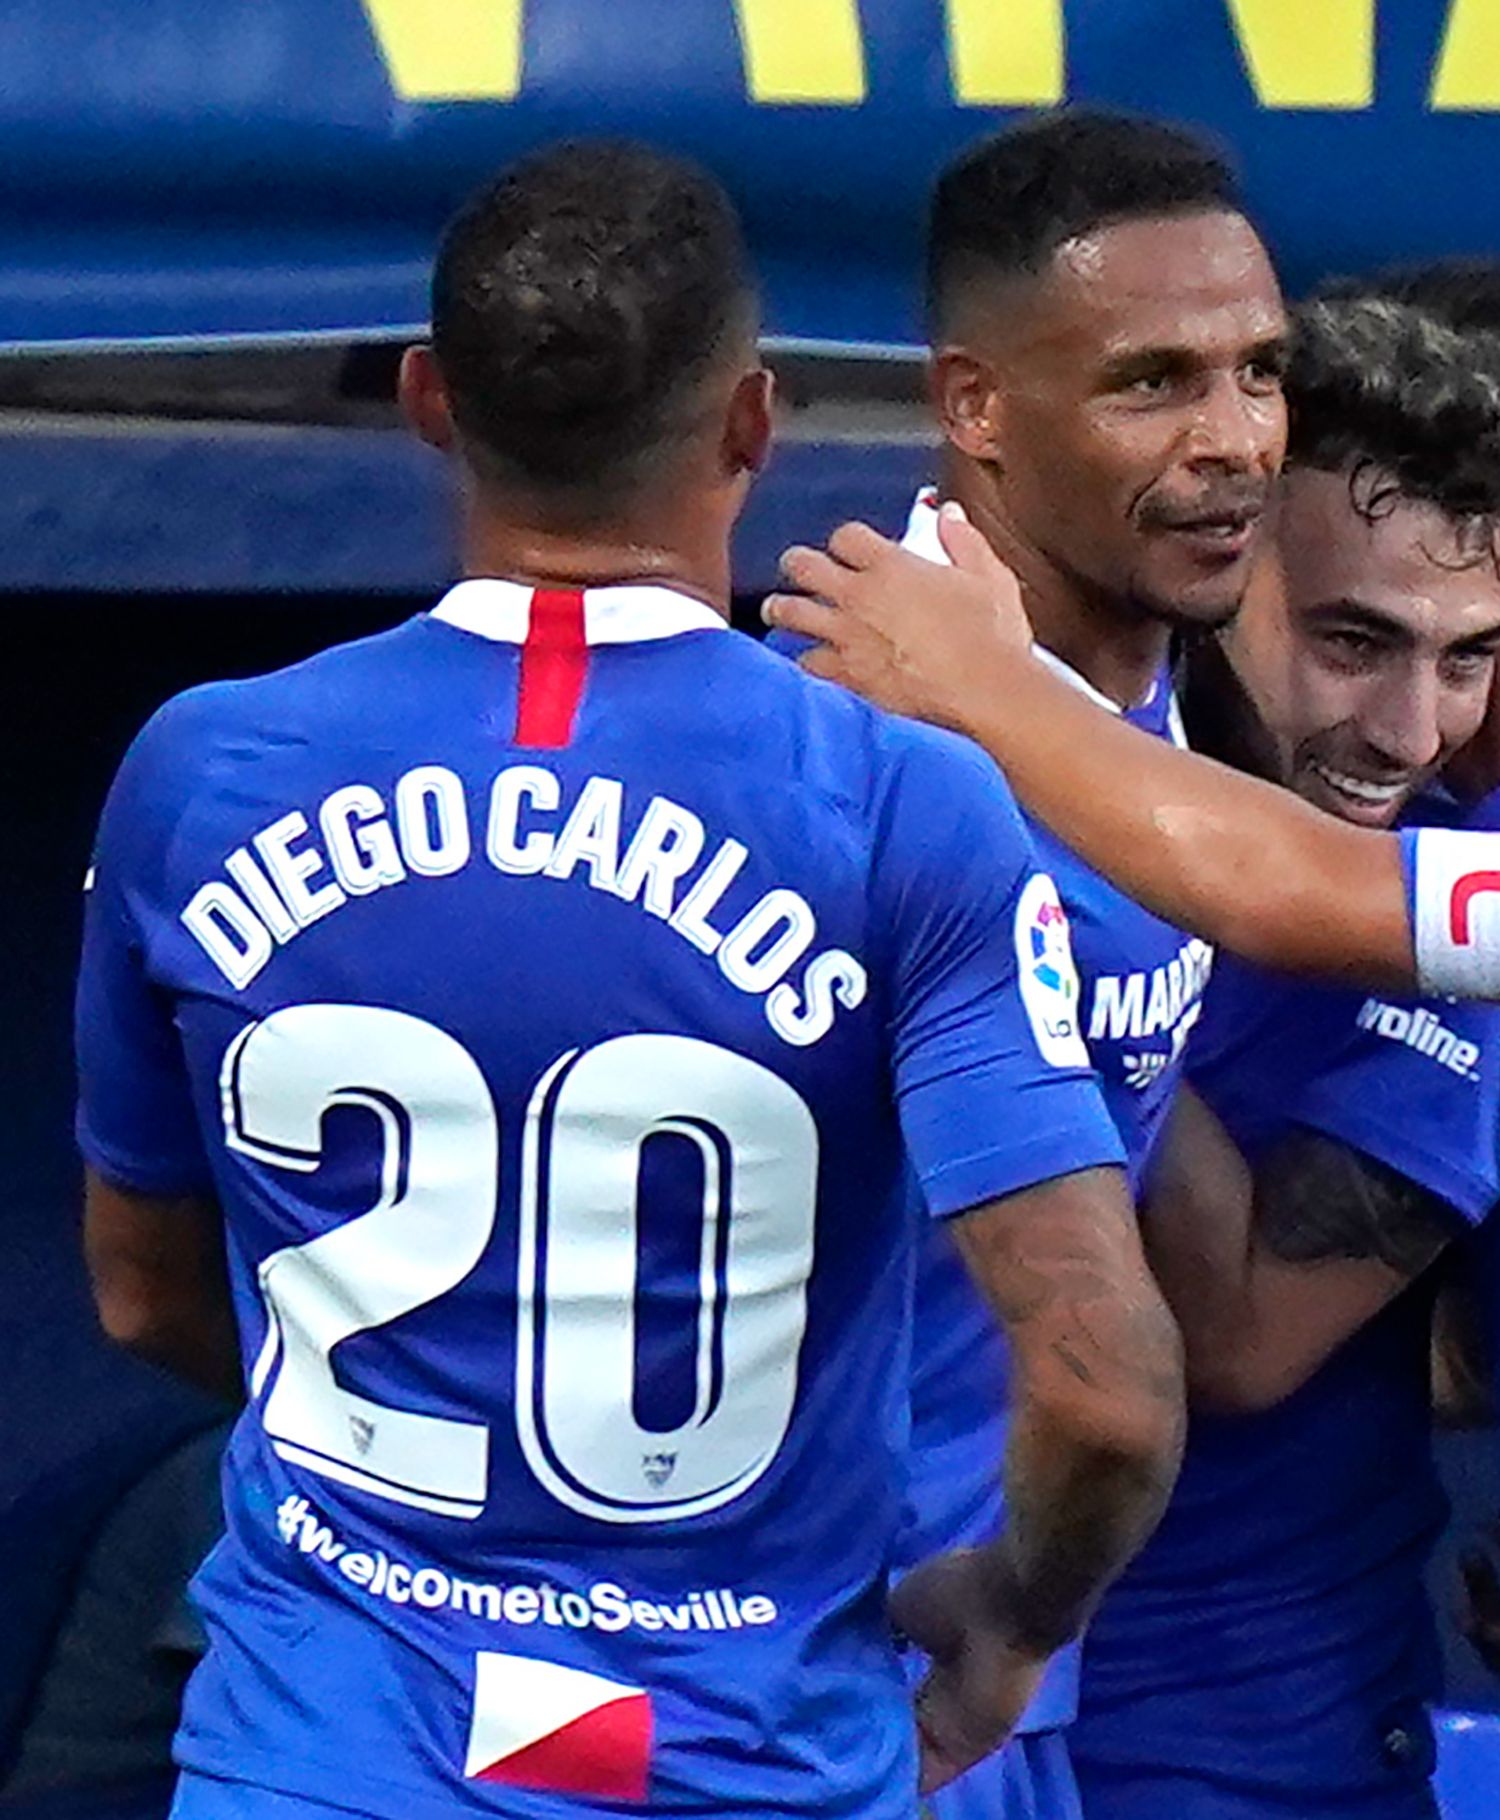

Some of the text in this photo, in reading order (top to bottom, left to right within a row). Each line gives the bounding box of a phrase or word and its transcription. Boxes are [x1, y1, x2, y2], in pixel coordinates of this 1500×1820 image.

[181, 765, 867, 1046] DIEGO CARLOS
[219, 1003, 820, 1522] 20
[276, 1493, 778, 1632] #welcometoSeville
